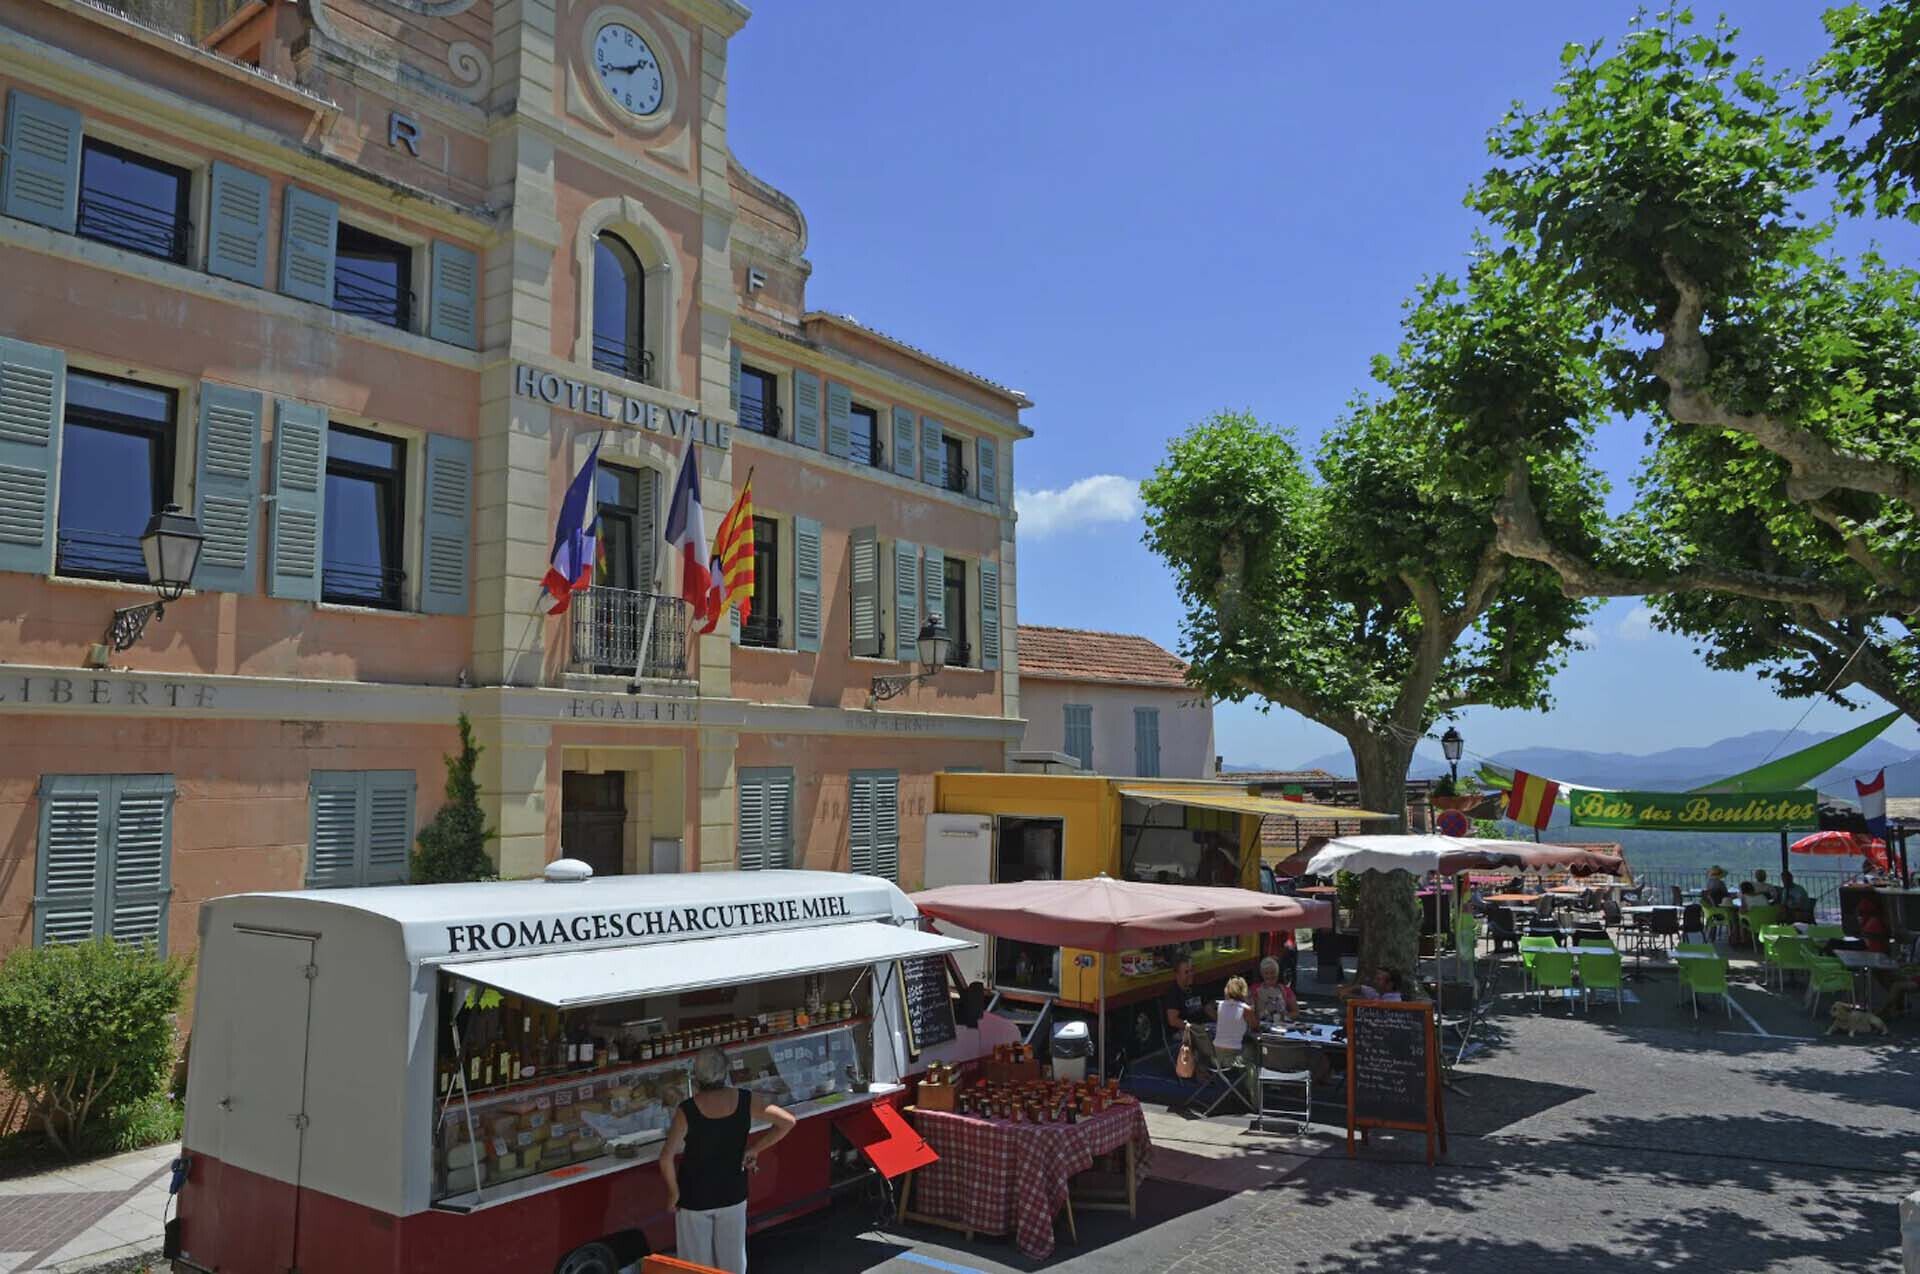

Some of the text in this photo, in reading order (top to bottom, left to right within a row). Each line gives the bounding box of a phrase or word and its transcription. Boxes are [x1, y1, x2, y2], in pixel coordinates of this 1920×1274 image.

[624, 31, 634, 48] 12
[597, 48, 604, 61] 9
[652, 78, 658, 90] 3
[625, 93, 632, 106] 6
[388, 112, 420, 158] R
[746, 266, 769, 295] F
[515, 365, 613, 419] HOTEL
[623, 397, 661, 431] DE
[0, 677, 217, 709] IBERTE
[1575, 793, 1814, 822] Bar des Boulistes
[446, 896, 850, 953] FROMAGES CHARCUTERIE MIEL
